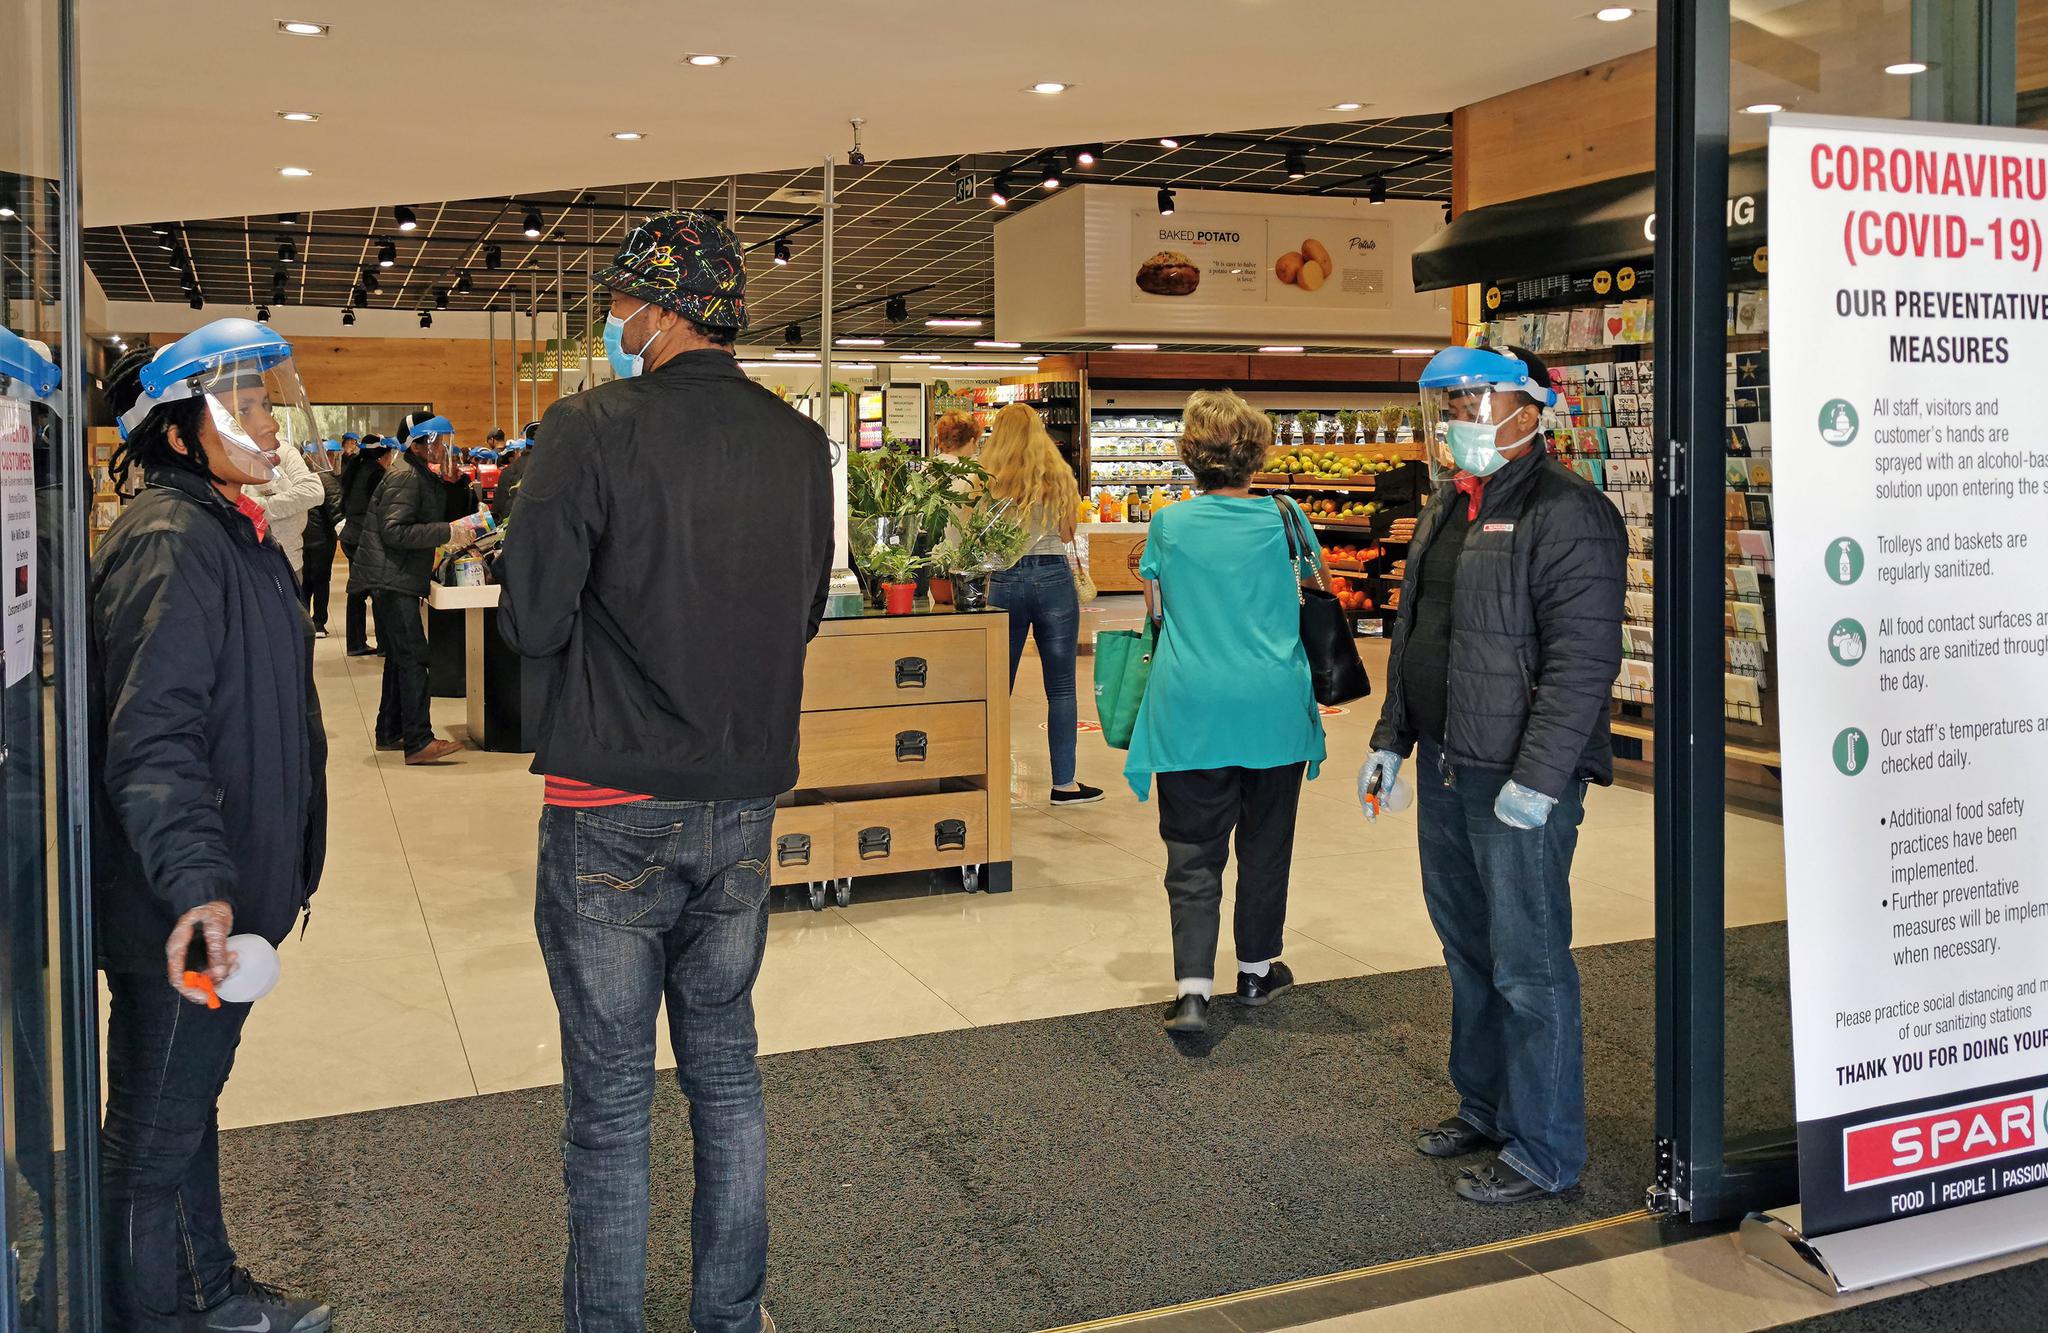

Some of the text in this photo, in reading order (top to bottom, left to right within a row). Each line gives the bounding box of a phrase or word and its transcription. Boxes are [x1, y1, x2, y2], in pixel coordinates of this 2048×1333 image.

[1811, 144, 2046, 201] CORONAVIRU
[1160, 230, 1240, 242] BAKED POTATO
[1349, 237, 1376, 250] Potato
[1844, 211, 2042, 272] (COVID-19)
[1836, 289, 1886, 317] OUR
[1890, 335, 2008, 363] MEASURES
[1873, 398, 1998, 418] All staff, visitors and
[1875, 425, 2008, 444] customer's hands are
[1876, 453, 1922, 474] sprayed
[1926, 453, 1953, 469] with
[1958, 456, 1973, 469] an
[1876, 480, 1922, 499] solution
[1927, 483, 1958, 501] upon
[1963, 478, 2013, 499] entering
[2018, 478, 2039, 494] the
[1877, 532, 2027, 556] Trolleys and baskets are
[1878, 558, 1993, 585] regularly sanitized.
[1879, 618, 1892, 636] All
[1897, 616, 1923, 635] food
[1928, 614, 1975, 633] contact
[1979, 611, 2032, 630] surfaces
[1880, 644, 1915, 664] hands
[1920, 646, 1940, 661] are
[1945, 638, 1999, 659] sanitized
[1880, 672, 1928, 692] the day.
[1881, 728, 1902, 746] Our
[1906, 724, 1945, 744] staff's
[1949, 718, 2033, 741] temperatures
[1882, 749, 1971, 774] checked daily.
[1890, 797, 2024, 828] Additional food safety
[1891, 826, 2016, 860] practices have been
[1892, 856, 1978, 885] implemented.
[1893, 878, 2019, 911] Further preventative
[1893, 916, 1955, 938] measures
[1960, 909, 1980, 928] will
[1986, 908, 2000, 924] be
[1893, 937, 2000, 965] when necessary.
[1836, 1010, 1871, 1028] Please
[1875, 1000, 1919, 1024] practice
[1924, 992, 1954, 1012] social
[1959, 986, 2013, 1001] distancing
[2017, 979, 2036, 996] and
[1899, 1006, 2032, 1040] of our sanitizing stations
[1836, 1058, 1887, 1086] THANK
[1893, 1052, 1922, 1074] YOU
[1929, 1046, 1957, 1068] FOR
[1963, 1036, 2008, 1061] DOING
[1892, 1105, 2031, 1166] SPAR
[1892, 1162, 2048, 1213] FOOD PEOPLE PASSION
